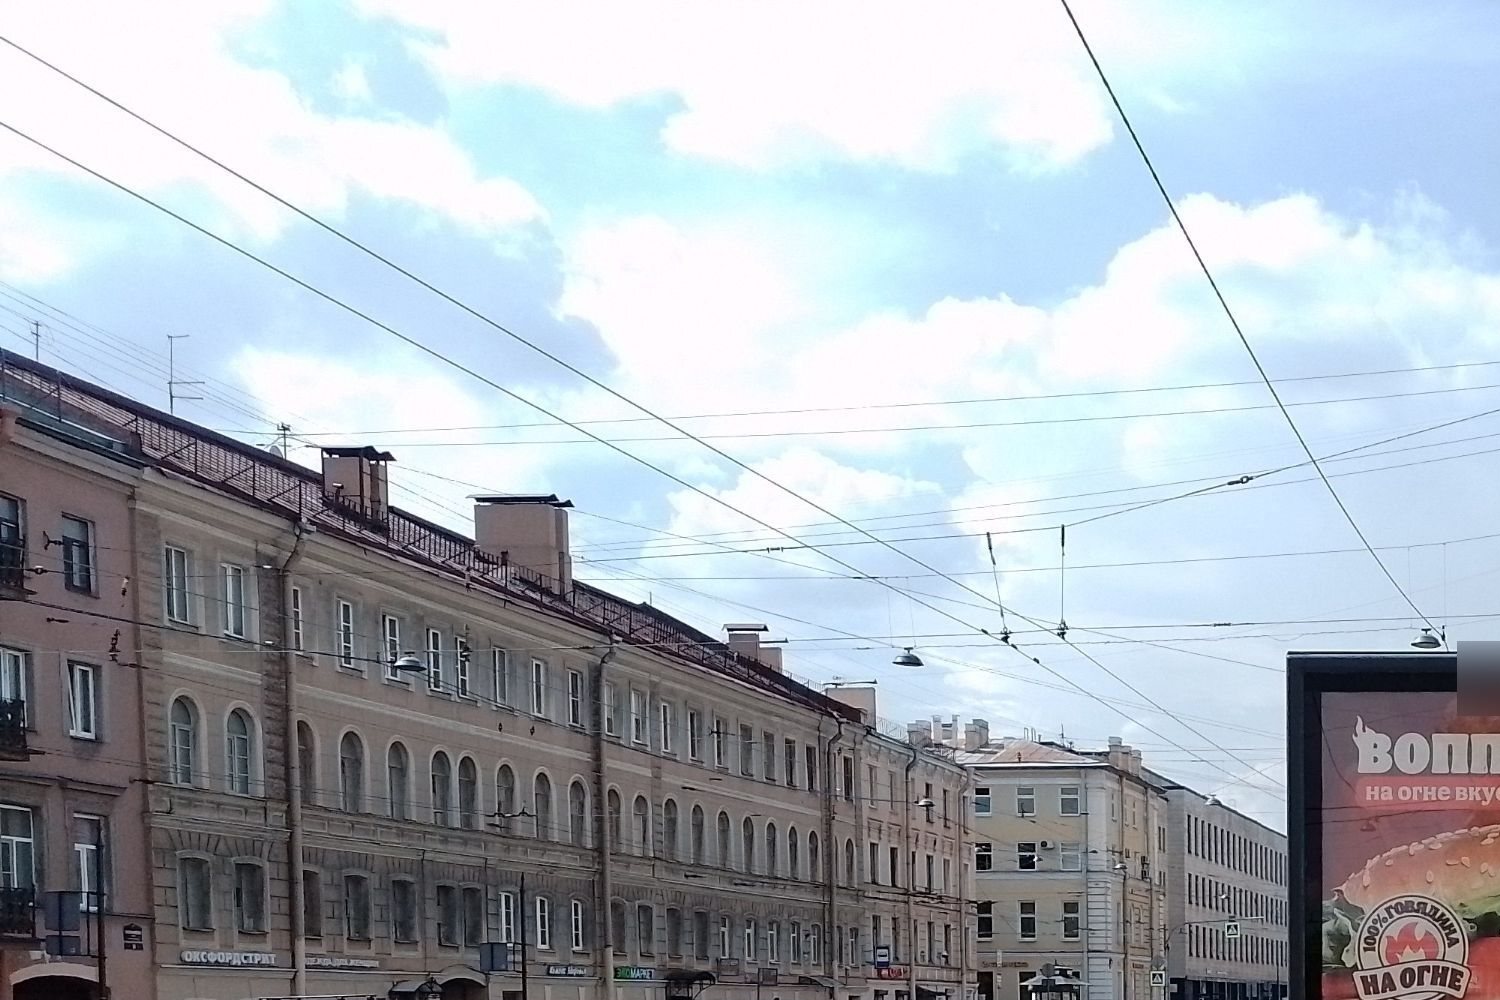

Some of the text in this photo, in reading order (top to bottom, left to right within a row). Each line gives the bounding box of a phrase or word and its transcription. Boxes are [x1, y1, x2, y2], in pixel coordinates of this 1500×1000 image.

[1366, 785, 1393, 801] на
[1397, 786, 1451, 801] огне
[1363, 900, 1460, 952] 100% ГОВЯДИНА
[1360, 965, 1464, 996] НА ОГНЕ
